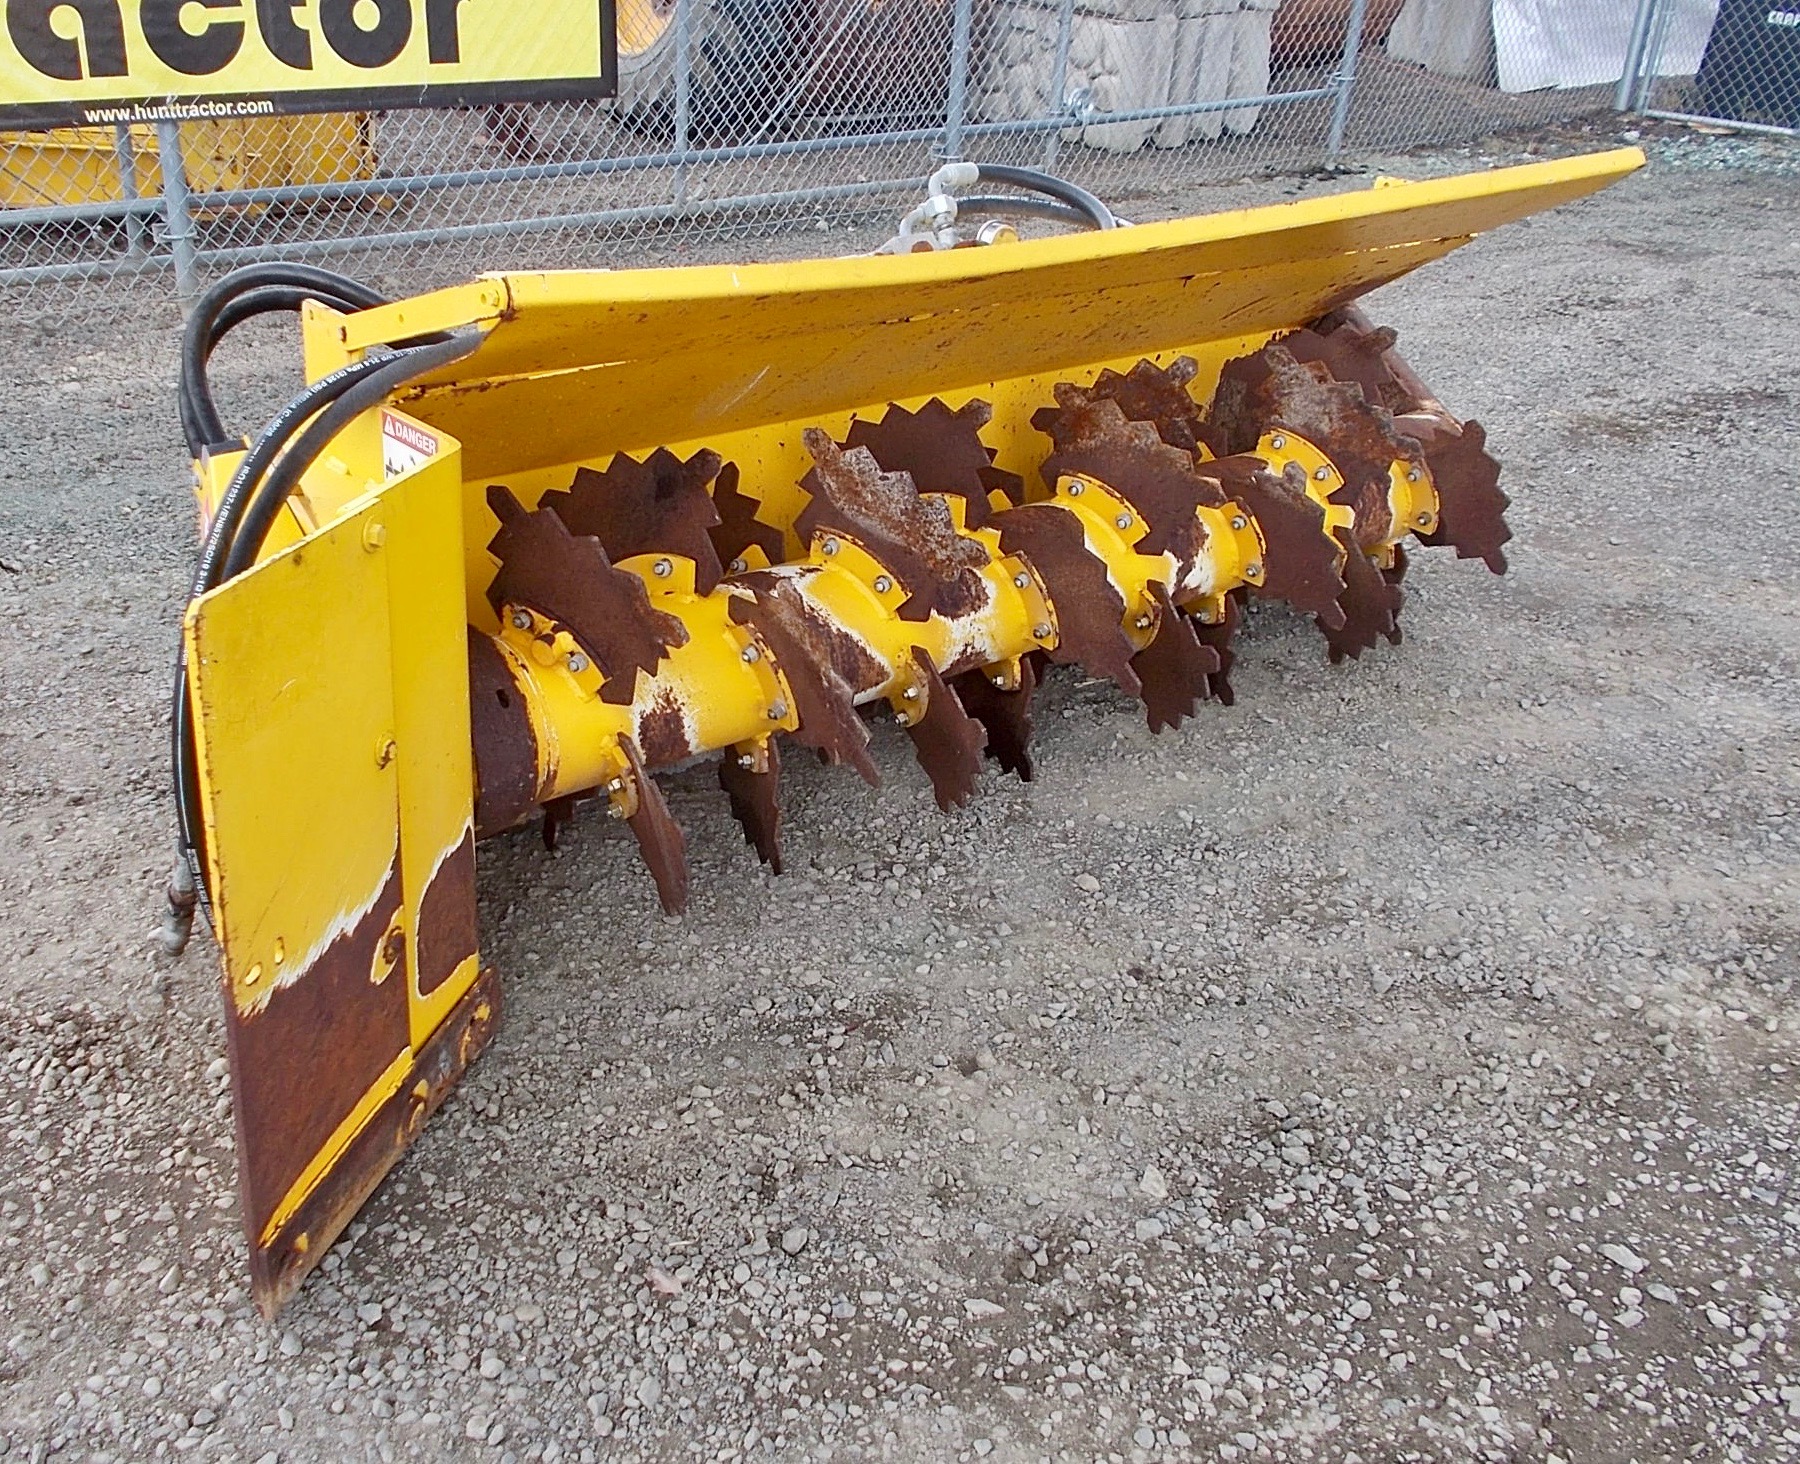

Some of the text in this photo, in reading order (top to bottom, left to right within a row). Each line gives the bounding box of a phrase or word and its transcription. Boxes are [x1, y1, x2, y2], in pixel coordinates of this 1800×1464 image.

[4, 0, 461, 80] actor
[84, 98, 274, 122] www.hunttractor.com
[395, 421, 437, 455] DANGER
